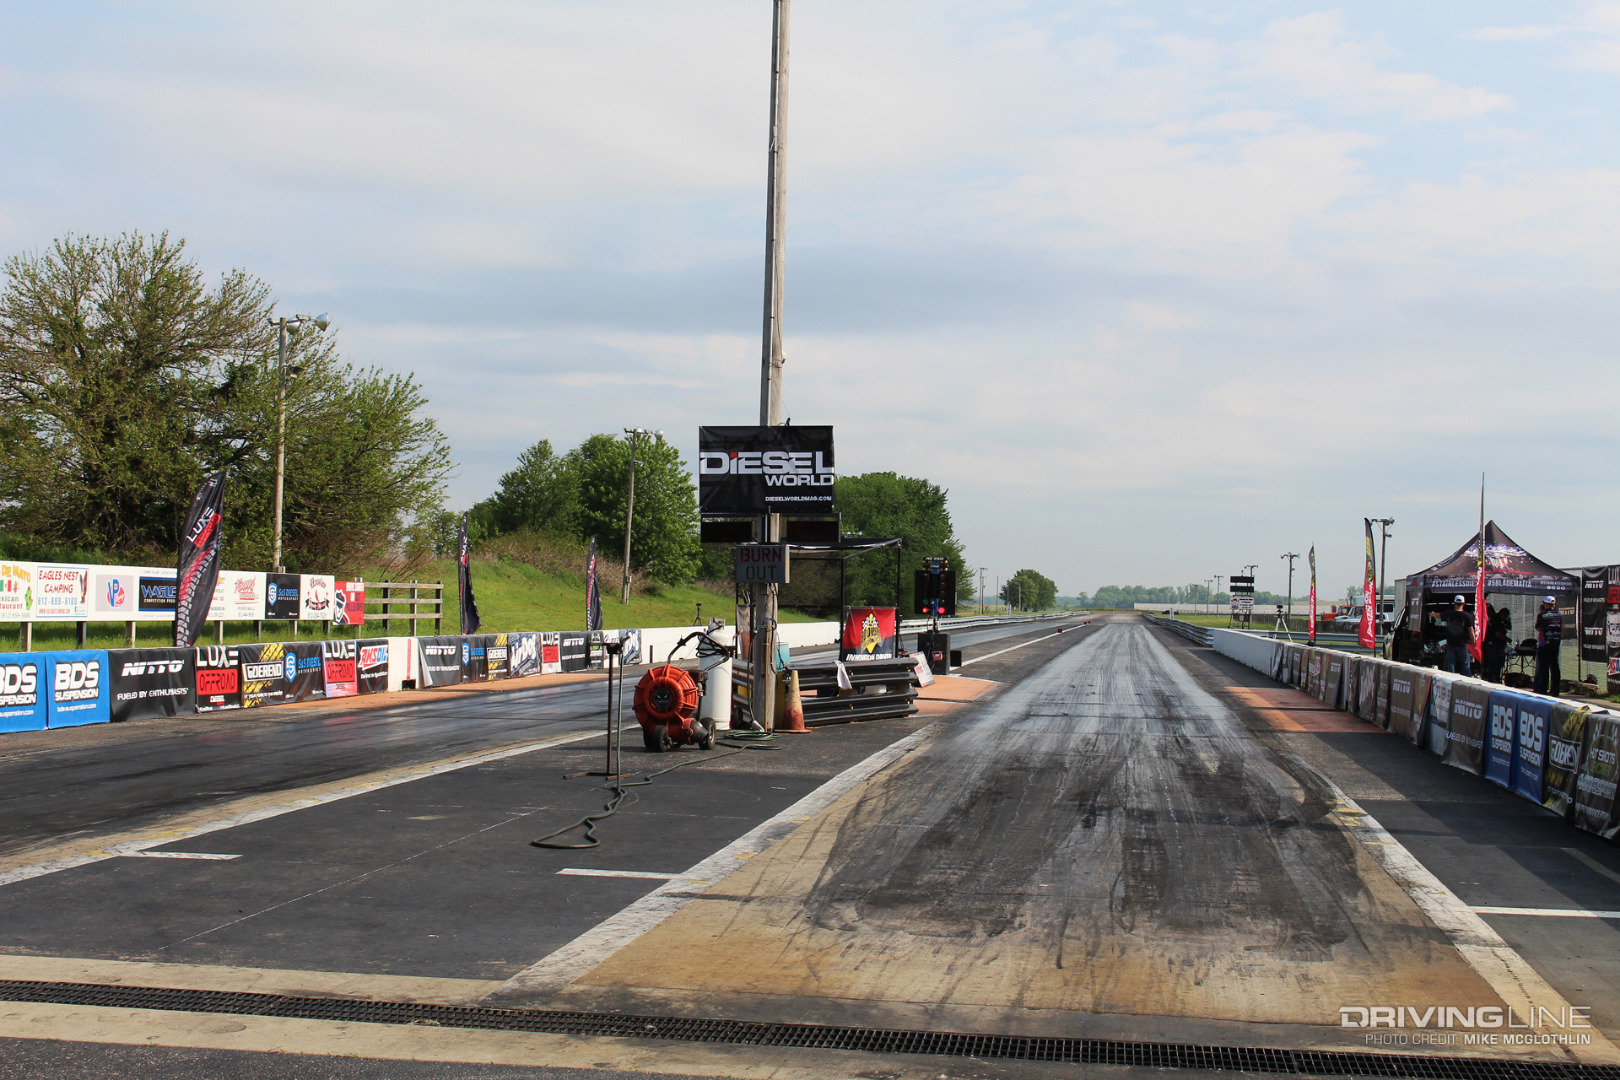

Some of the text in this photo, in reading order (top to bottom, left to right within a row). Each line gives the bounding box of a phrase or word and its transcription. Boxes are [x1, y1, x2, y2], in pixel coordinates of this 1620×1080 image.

[765, 475, 834, 486] WORLD
[187, 507, 215, 542] LUXE
[741, 548, 782, 562] BURN
[2, 565, 31, 583] DE MAYO
[39, 570, 79, 581] EAGLES NEST
[745, 565, 777, 581] OUT
[45, 584, 74, 593] CAMPING
[196, 646, 239, 668] LUXE
[324, 641, 356, 659] LUXE
[425, 645, 456, 655] NITTO
[54, 661, 99, 691] BDS
[121, 660, 184, 677] NITTO
[247, 664, 282, 678] GOEREND
[200, 672, 235, 691] OFFROAD
[54, 688, 98, 702] SUSPENSION
[117, 691, 138, 700] FUELED
[139, 690, 147, 698] BY
[1454, 699, 1483, 719] NITTO
[1492, 704, 1513, 740] BDS
[1520, 710, 1543, 752] BDS
